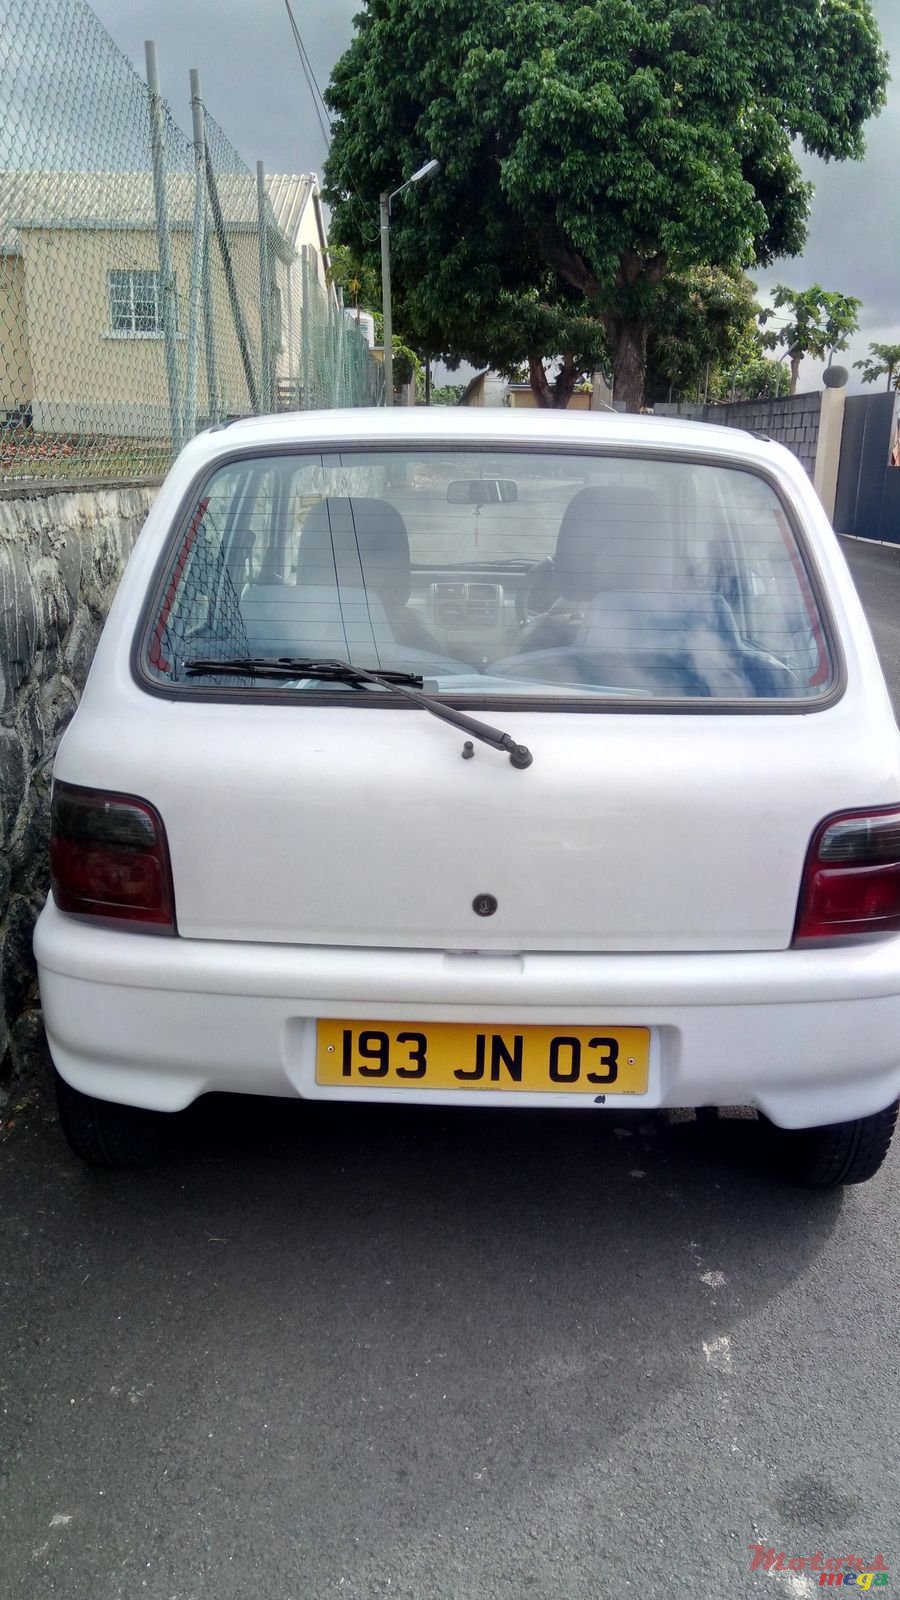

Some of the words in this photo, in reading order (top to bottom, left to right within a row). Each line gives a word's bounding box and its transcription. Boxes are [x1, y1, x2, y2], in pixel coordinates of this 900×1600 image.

[342, 1029, 428, 1079] 193
[453, 1034, 524, 1082] JN
[549, 1036, 620, 1084] 03
